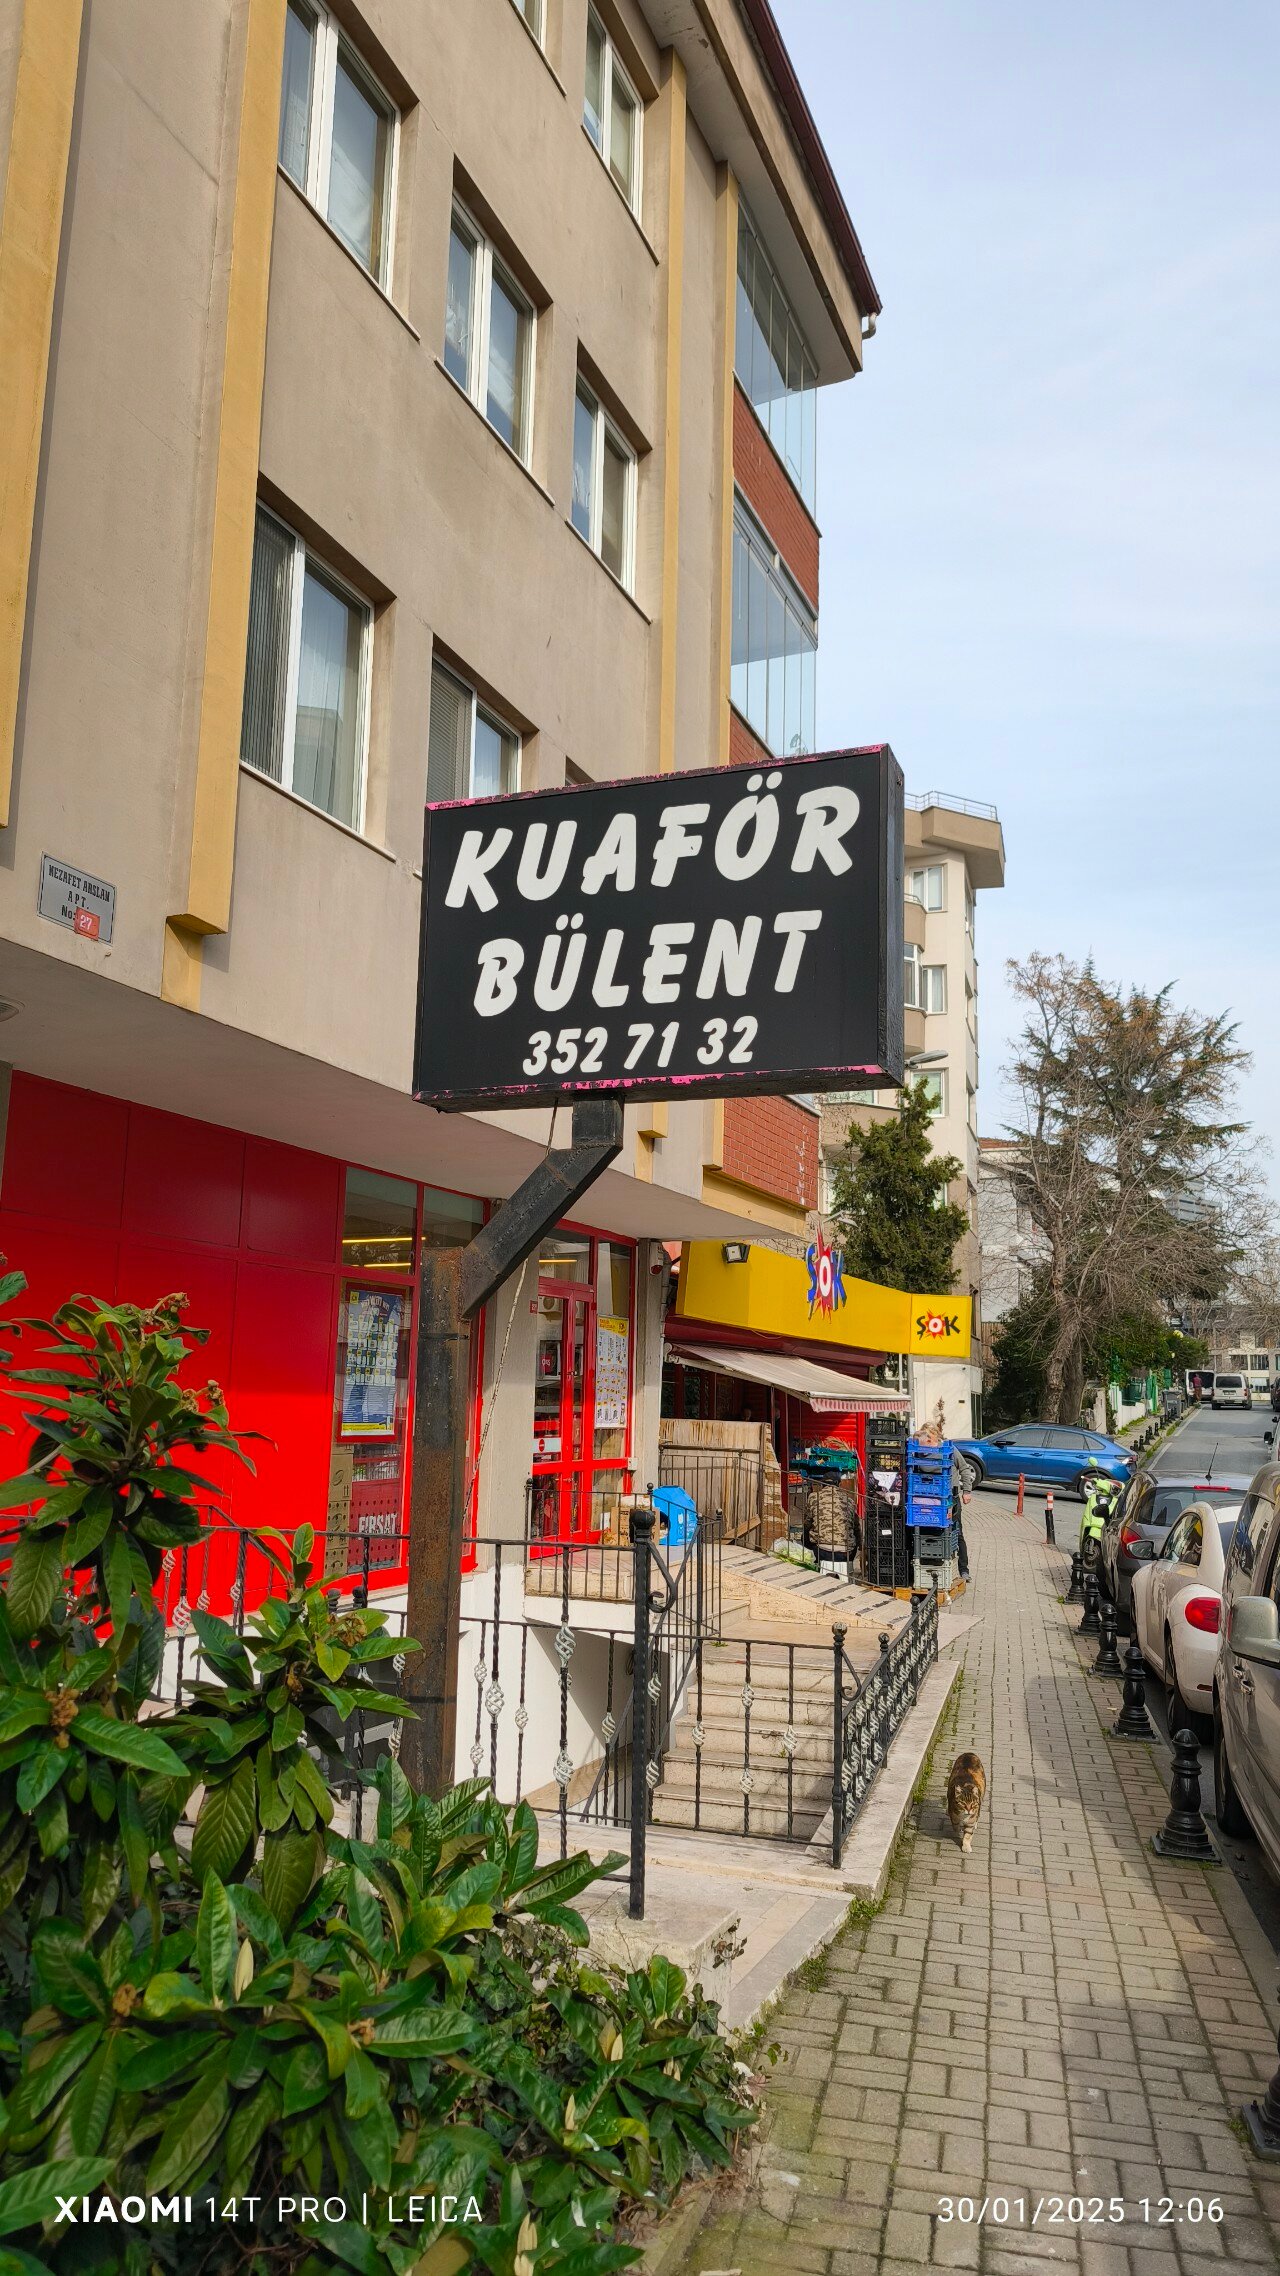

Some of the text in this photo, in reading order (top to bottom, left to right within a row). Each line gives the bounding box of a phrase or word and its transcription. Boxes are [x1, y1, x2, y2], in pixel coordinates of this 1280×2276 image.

[444, 771, 861, 913] KUAFÖR
[48, 864, 111, 903] NEZAFET ARSLAN
[79, 914, 93, 930] 27
[473, 909, 823, 1018] BÜLENT
[522, 1015, 759, 1077] 352 71 32
[806, 1240, 848, 1322] ŞOK
[916, 1313, 961, 1341] ŞOK
